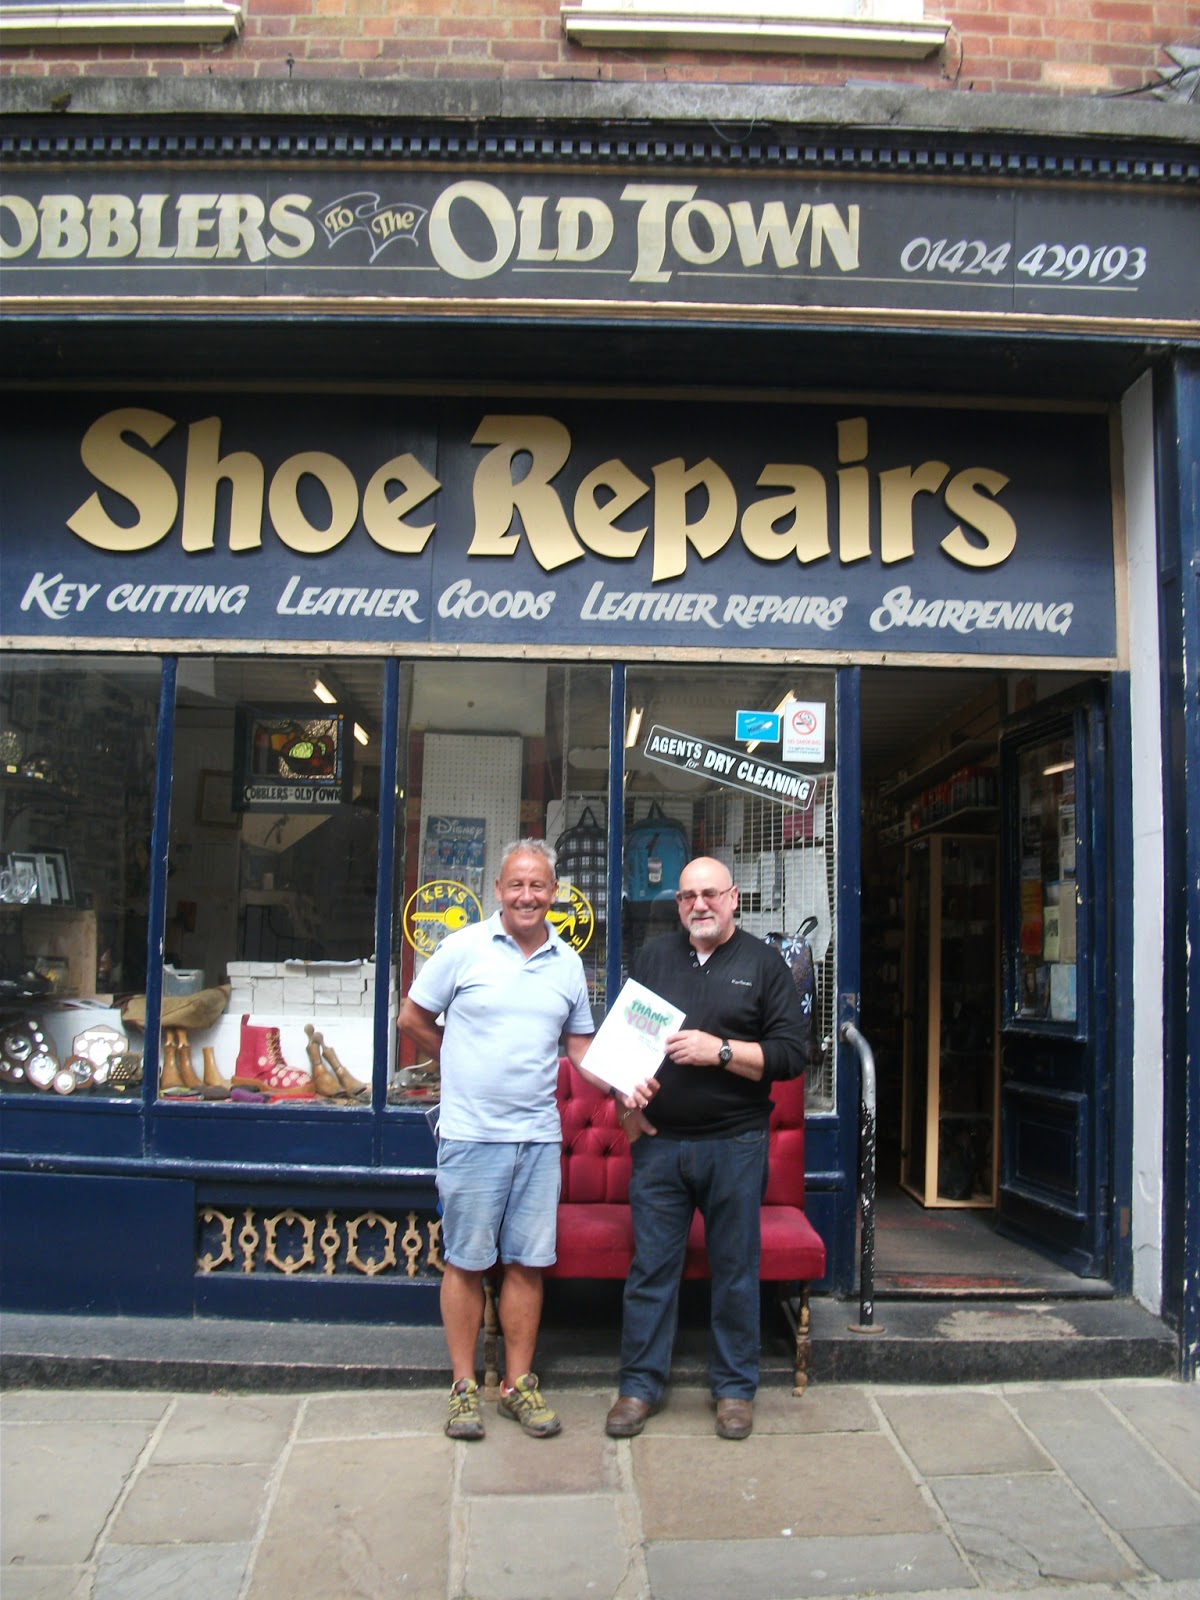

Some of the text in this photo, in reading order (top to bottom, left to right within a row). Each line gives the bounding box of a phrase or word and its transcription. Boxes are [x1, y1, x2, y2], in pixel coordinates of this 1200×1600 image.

[325, 205, 354, 234] To
[371, 209, 415, 240] The
[429, 180, 614, 279] OLD
[620, 183, 860, 282] TOWN
[900, 237, 1012, 275] 01424
[1017, 243, 1147, 282] 429193
[66, 407, 1018, 583] Shoe Repairs
[20, 572, 1075, 636] KEY CUTTING LEATHER GOODS LEATHER REPAIRS SHARPENING
[650, 735, 811, 801] AGENTS for DRY CLEANING
[421, 885, 468, 904] KEYS
[627, 1009, 661, 1036] YOU
[631, 1000, 669, 1027] THANK
